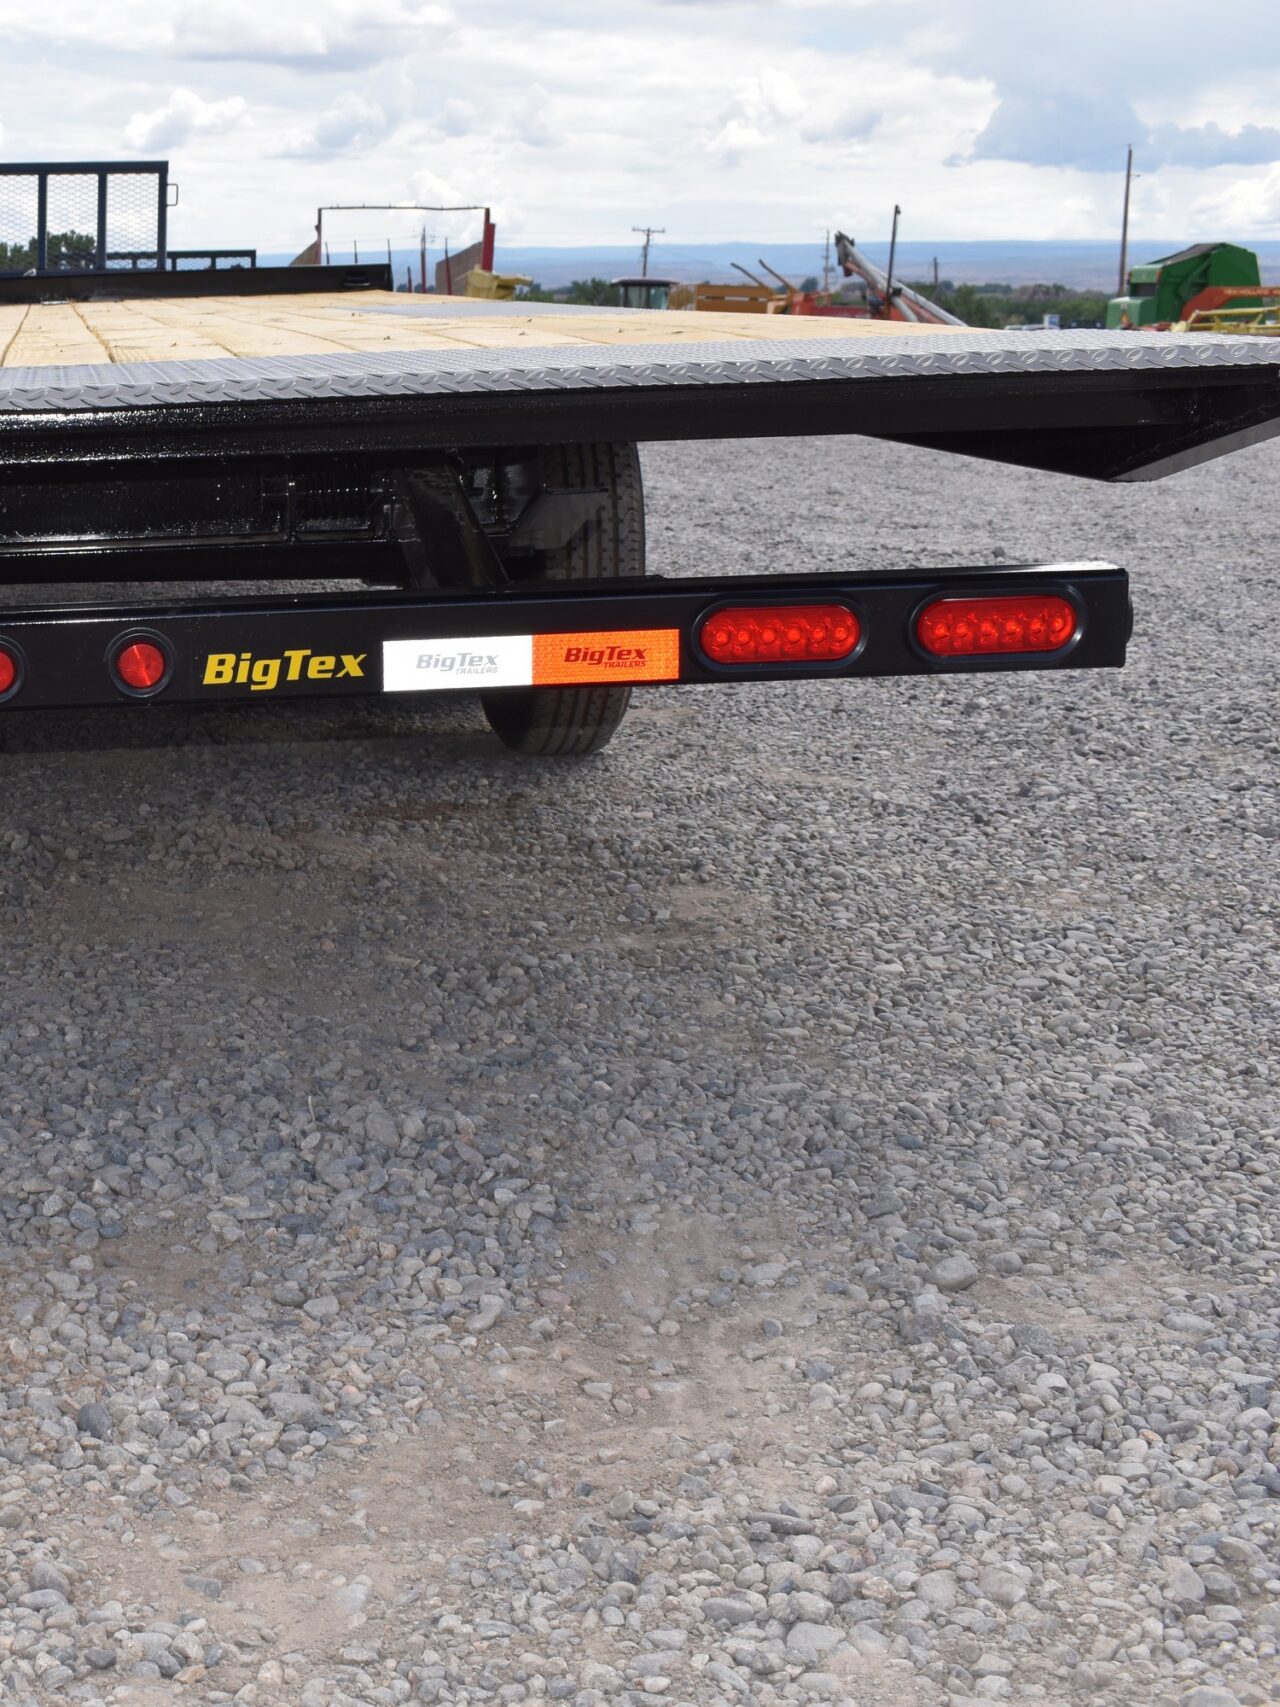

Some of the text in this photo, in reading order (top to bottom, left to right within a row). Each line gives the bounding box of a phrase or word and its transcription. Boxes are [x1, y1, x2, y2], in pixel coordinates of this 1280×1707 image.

[416, 652, 499, 672] BigTex
[564, 646, 647, 665] BigTex
[604, 660, 647, 669] TRAILERS
[202, 649, 367, 691] BigTex
[456, 666, 499, 675] TRAILERS
